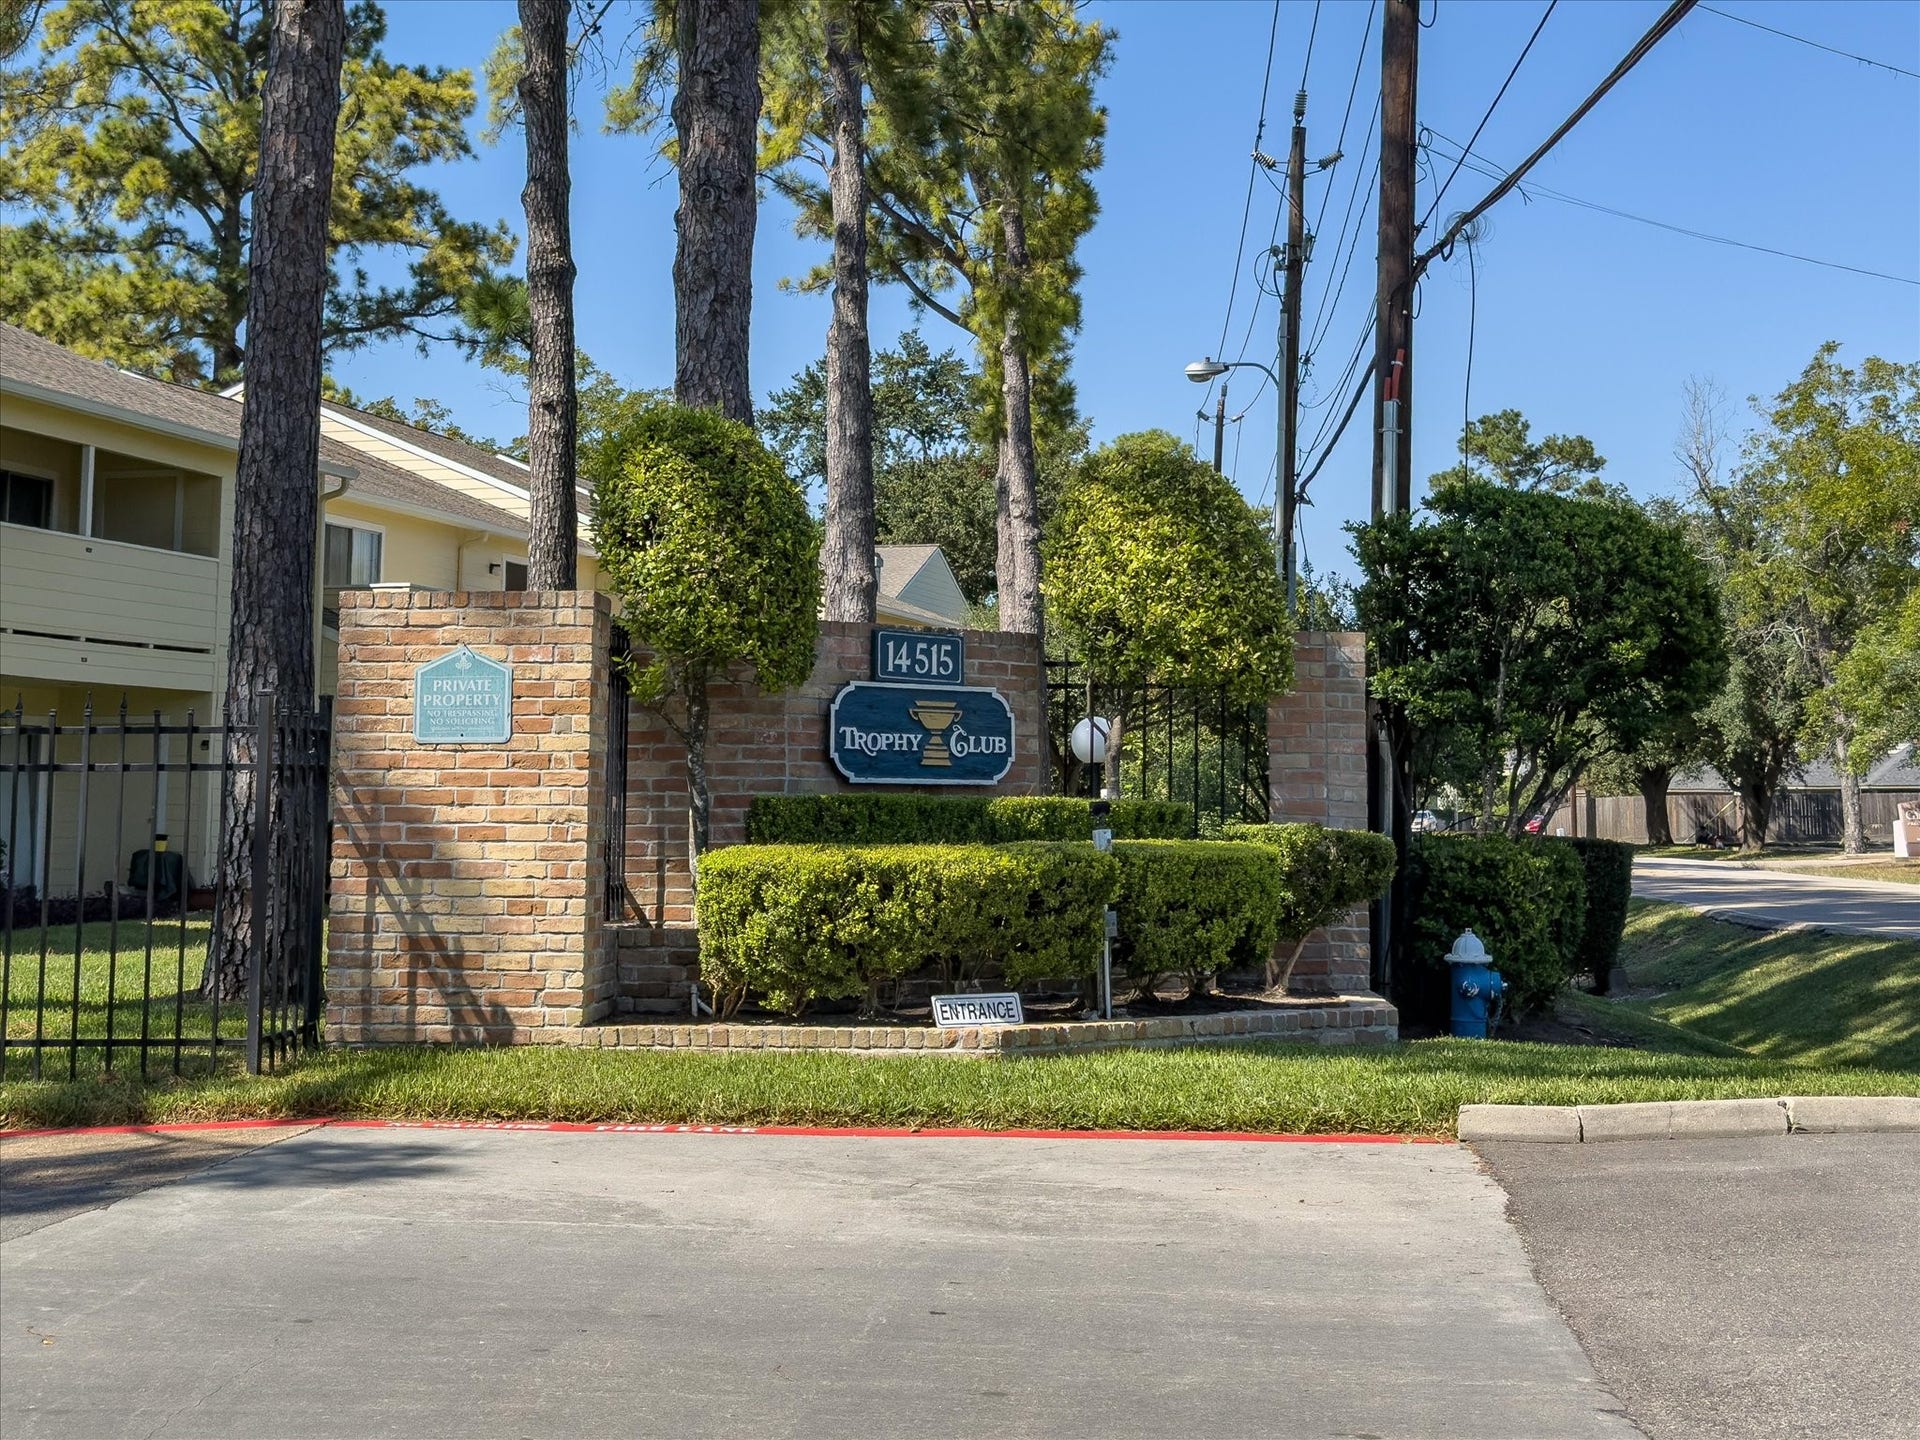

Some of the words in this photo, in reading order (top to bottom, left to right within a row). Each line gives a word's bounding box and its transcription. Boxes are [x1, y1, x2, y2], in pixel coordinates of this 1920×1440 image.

[886, 640, 953, 676] 14515
[433, 679, 492, 692] PRIVATE
[423, 693, 501, 706] PROPERTY
[427, 709, 441, 717] NO
[443, 709, 497, 717] TRESPASSING
[430, 717, 443, 725] NO
[445, 717, 495, 725] SOLICITING
[839, 726, 923, 757] TROPHY
[950, 724, 1007, 758] CLUB
[939, 1001, 1016, 1020] ENTRANCE
